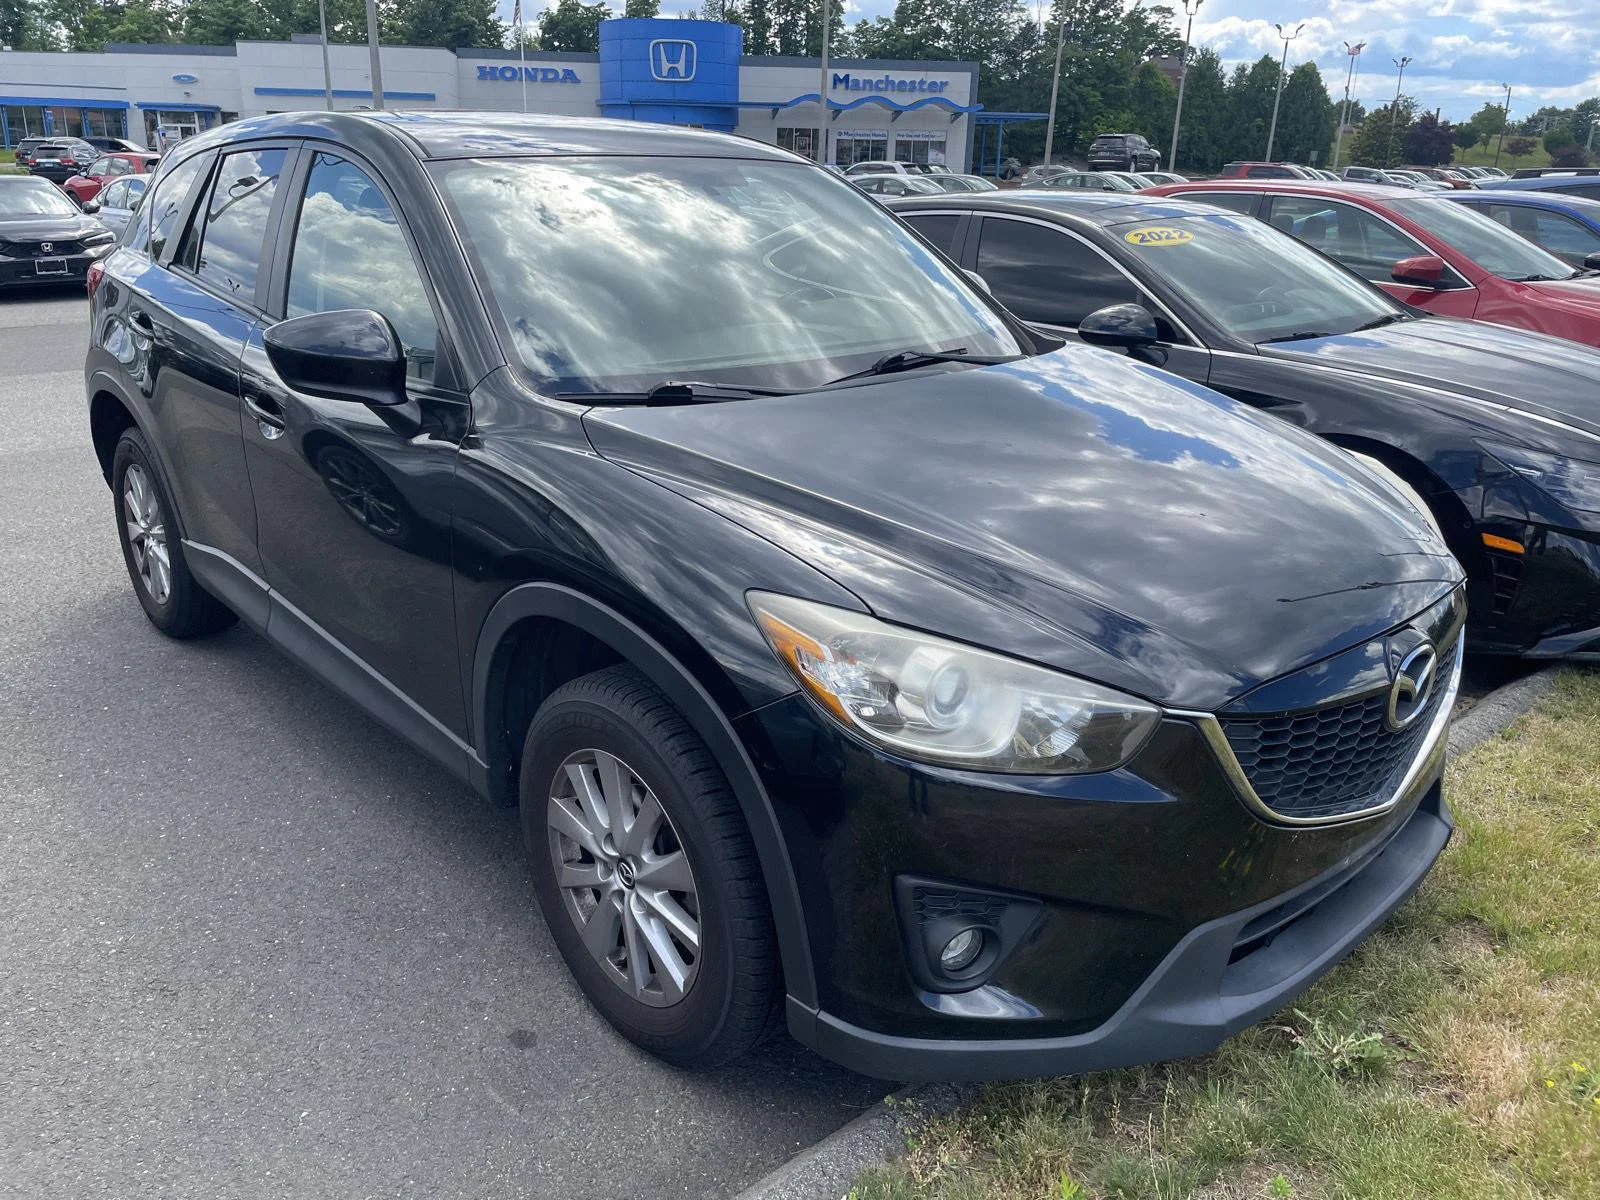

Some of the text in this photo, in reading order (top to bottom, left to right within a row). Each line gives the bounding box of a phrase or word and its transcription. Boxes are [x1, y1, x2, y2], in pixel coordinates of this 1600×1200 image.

[477, 66, 581, 83] HONDA
[832, 73, 949, 93] Manchester
[1134, 230, 1190, 243] 2022
